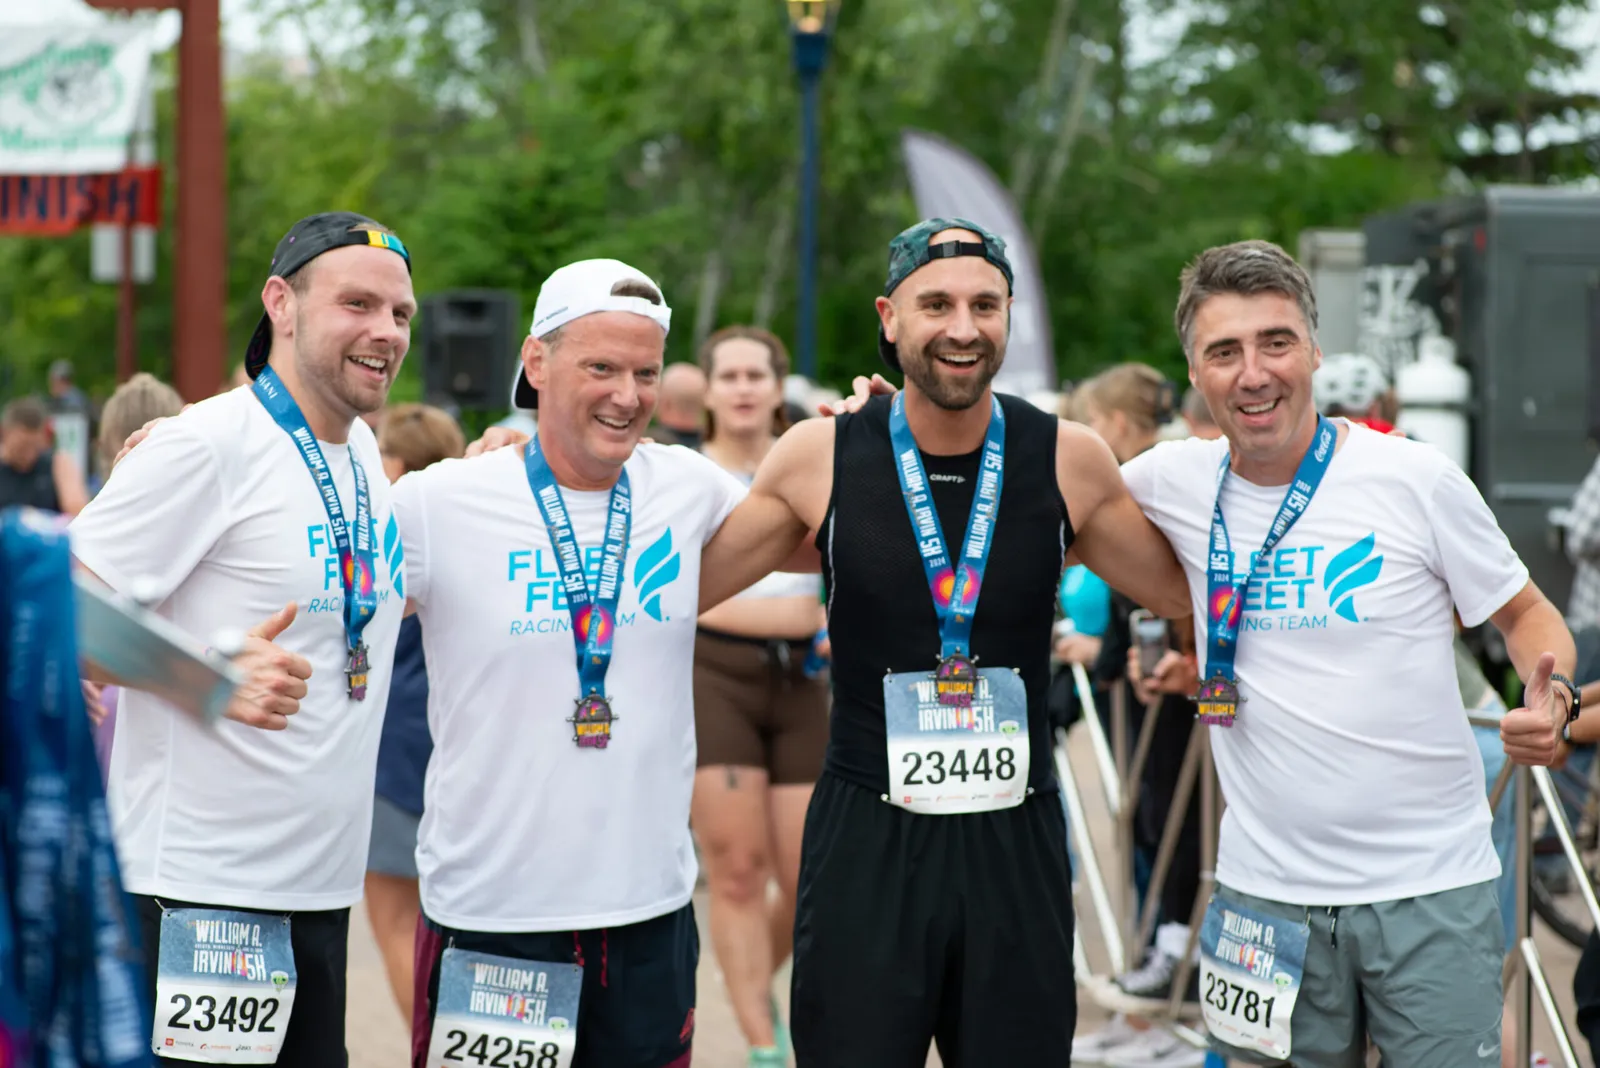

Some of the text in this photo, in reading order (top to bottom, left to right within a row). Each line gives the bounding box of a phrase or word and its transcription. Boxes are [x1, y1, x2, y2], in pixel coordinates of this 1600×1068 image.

[292, 427, 325, 470] WILLIAM
[322, 484, 341, 516] IRVIN
[930, 474, 956, 482] CRAFT
[900, 449, 925, 492] WILLIAM
[916, 506, 937, 538] IRVIN
[357, 506, 370, 551] WILLIAM
[538, 484, 568, 528] WILLIAM
[560, 540, 580, 572] IRVIN
[608, 512, 627, 541] IRVIN
[965, 513, 990, 559] WILLIAM
[980, 470, 998, 499] IRVIN
[1273, 507, 1296, 537] IRVIN
[597, 554, 620, 599] WILLIAM
[1230, 546, 1324, 578] LEET
[1232, 578, 1315, 611] EET
[510, 618, 575, 635] RACIN
[1278, 615, 1327, 630] TEAM
[918, 707, 956, 731] IRVIN
[902, 747, 1016, 786] 23448
[196, 919, 249, 945] WILLIAM
[1223, 909, 1262, 943] WILLIAM
[193, 950, 232, 974] IRVIN
[474, 963, 533, 992] WILLIAM
[167, 993, 279, 1033] 23492
[469, 990, 508, 1016] IRVIN
[1205, 971, 1275, 1028] 23781
[443, 1029, 559, 1068] 24258
